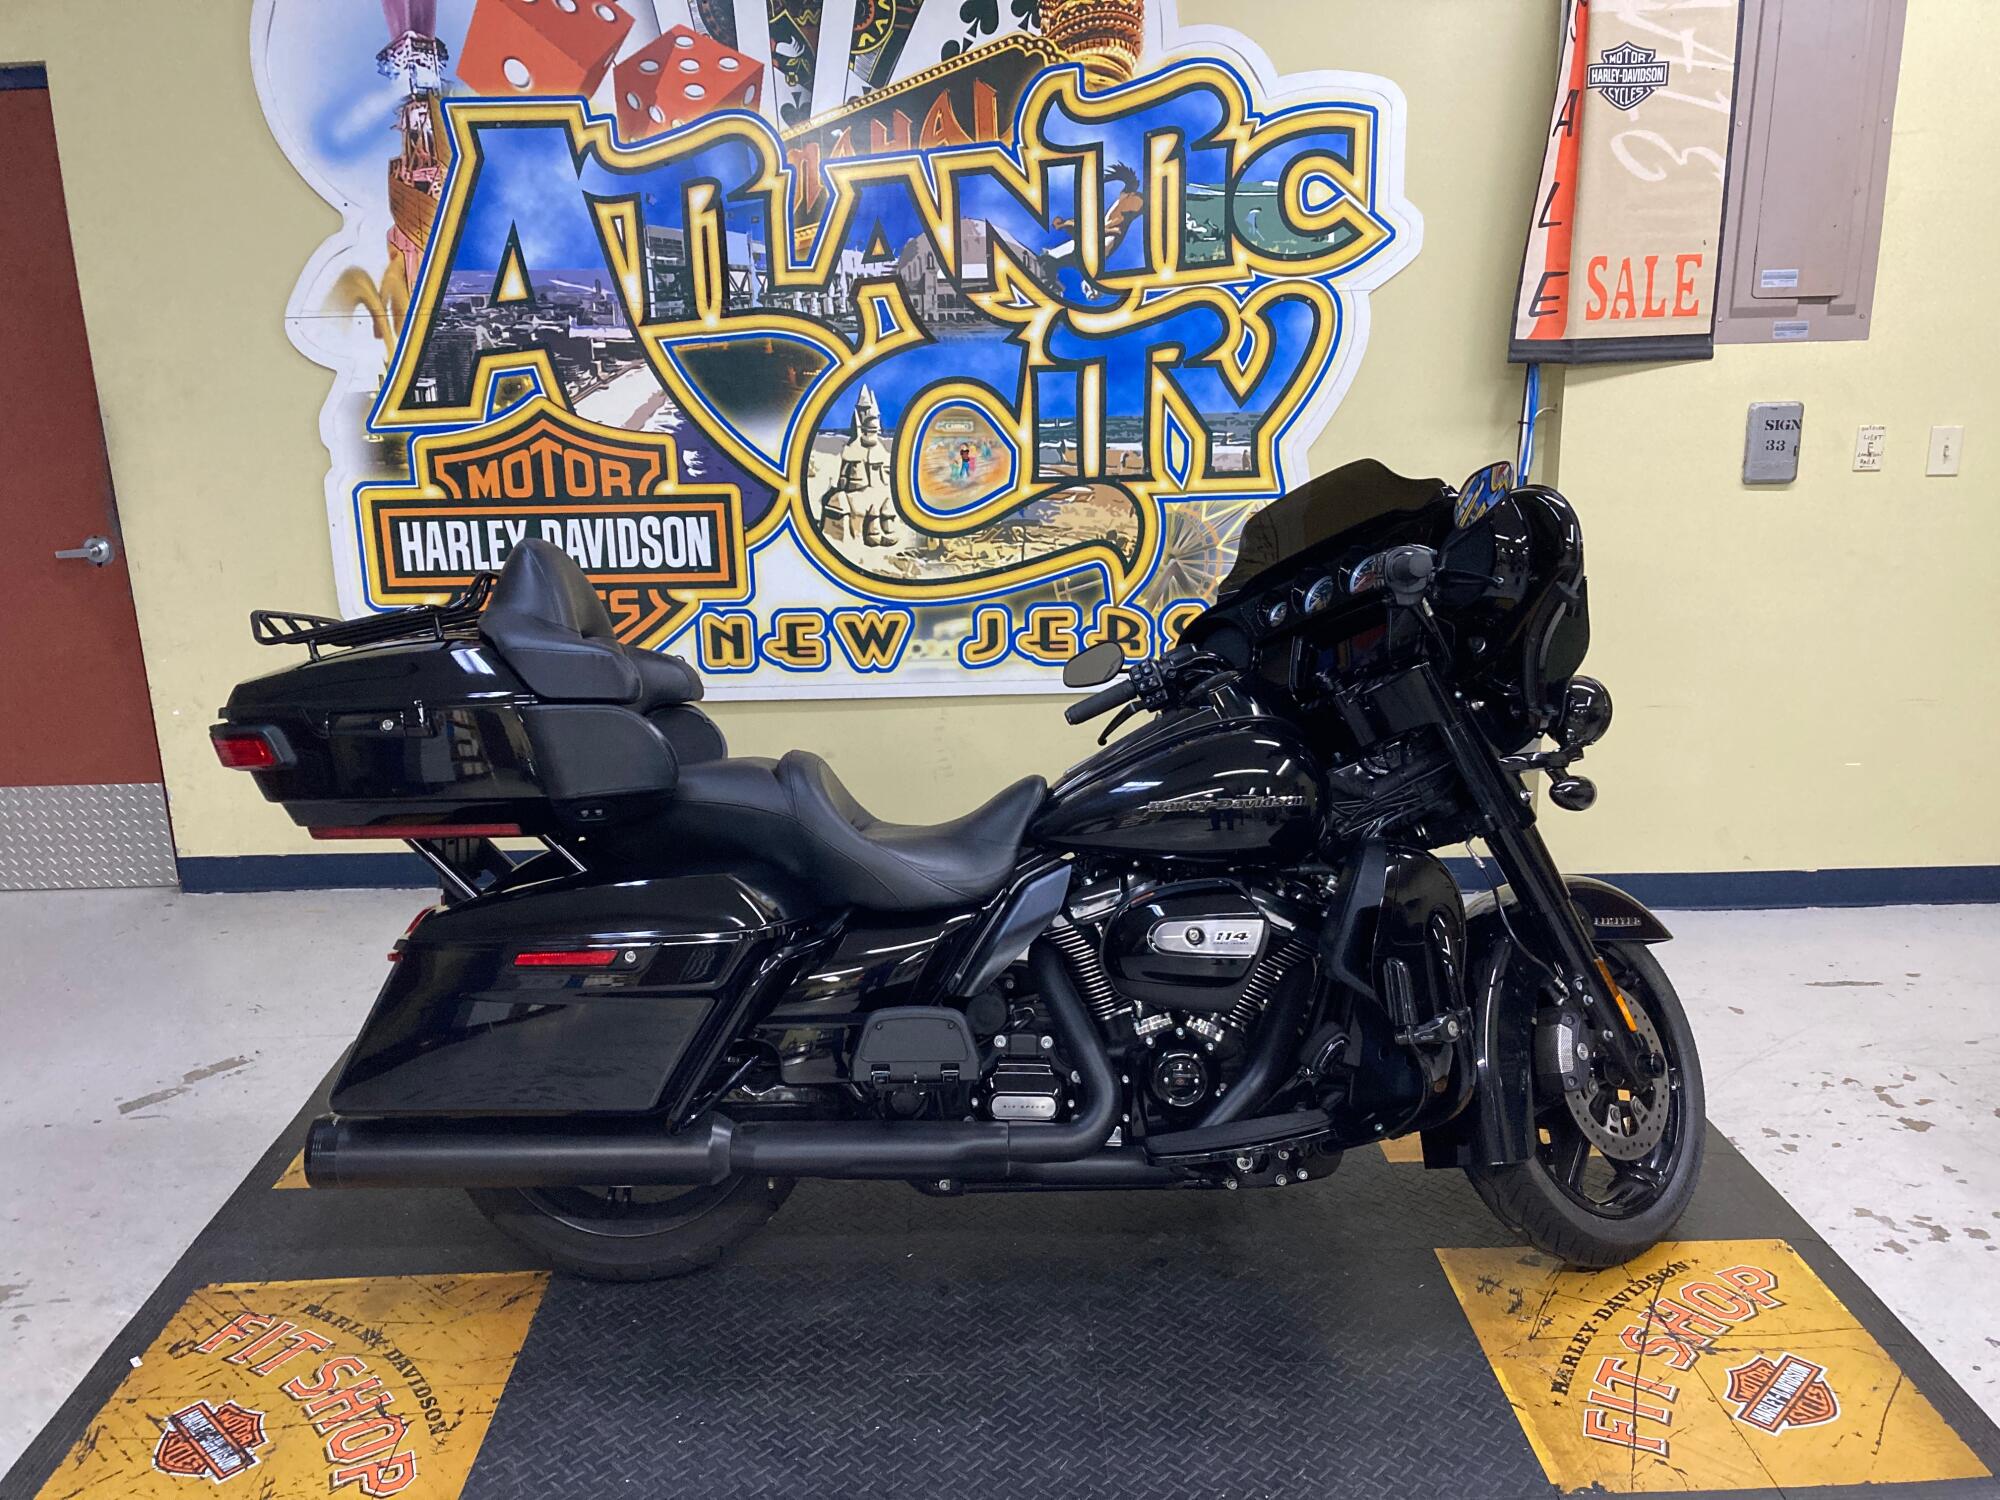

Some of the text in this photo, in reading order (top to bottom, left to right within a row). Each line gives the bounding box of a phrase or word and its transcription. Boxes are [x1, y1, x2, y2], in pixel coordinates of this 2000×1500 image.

[1591, 67, 1664, 83] HARLEY-DAVIDSON
[1609, 48, 1646, 64] MOTOR
[1608, 86, 1645, 105] CYCLES
[368, 57, 1395, 432] ATLANTIC
[1585, 254, 1703, 321] SALE
[788, 282, 1340, 604] CITY
[1764, 419, 1802, 431] SIGN
[1766, 440, 1786, 451] 33
[467, 437, 632, 499] MOTOR
[703, 609, 909, 668] NEW
[1148, 795, 1305, 813] Harley-Davidson
[1215, 931, 1250, 942] 114
[1583, 1264, 1779, 1458] FIT SHOP
[195, 1311, 417, 1499] FIT SHOP
